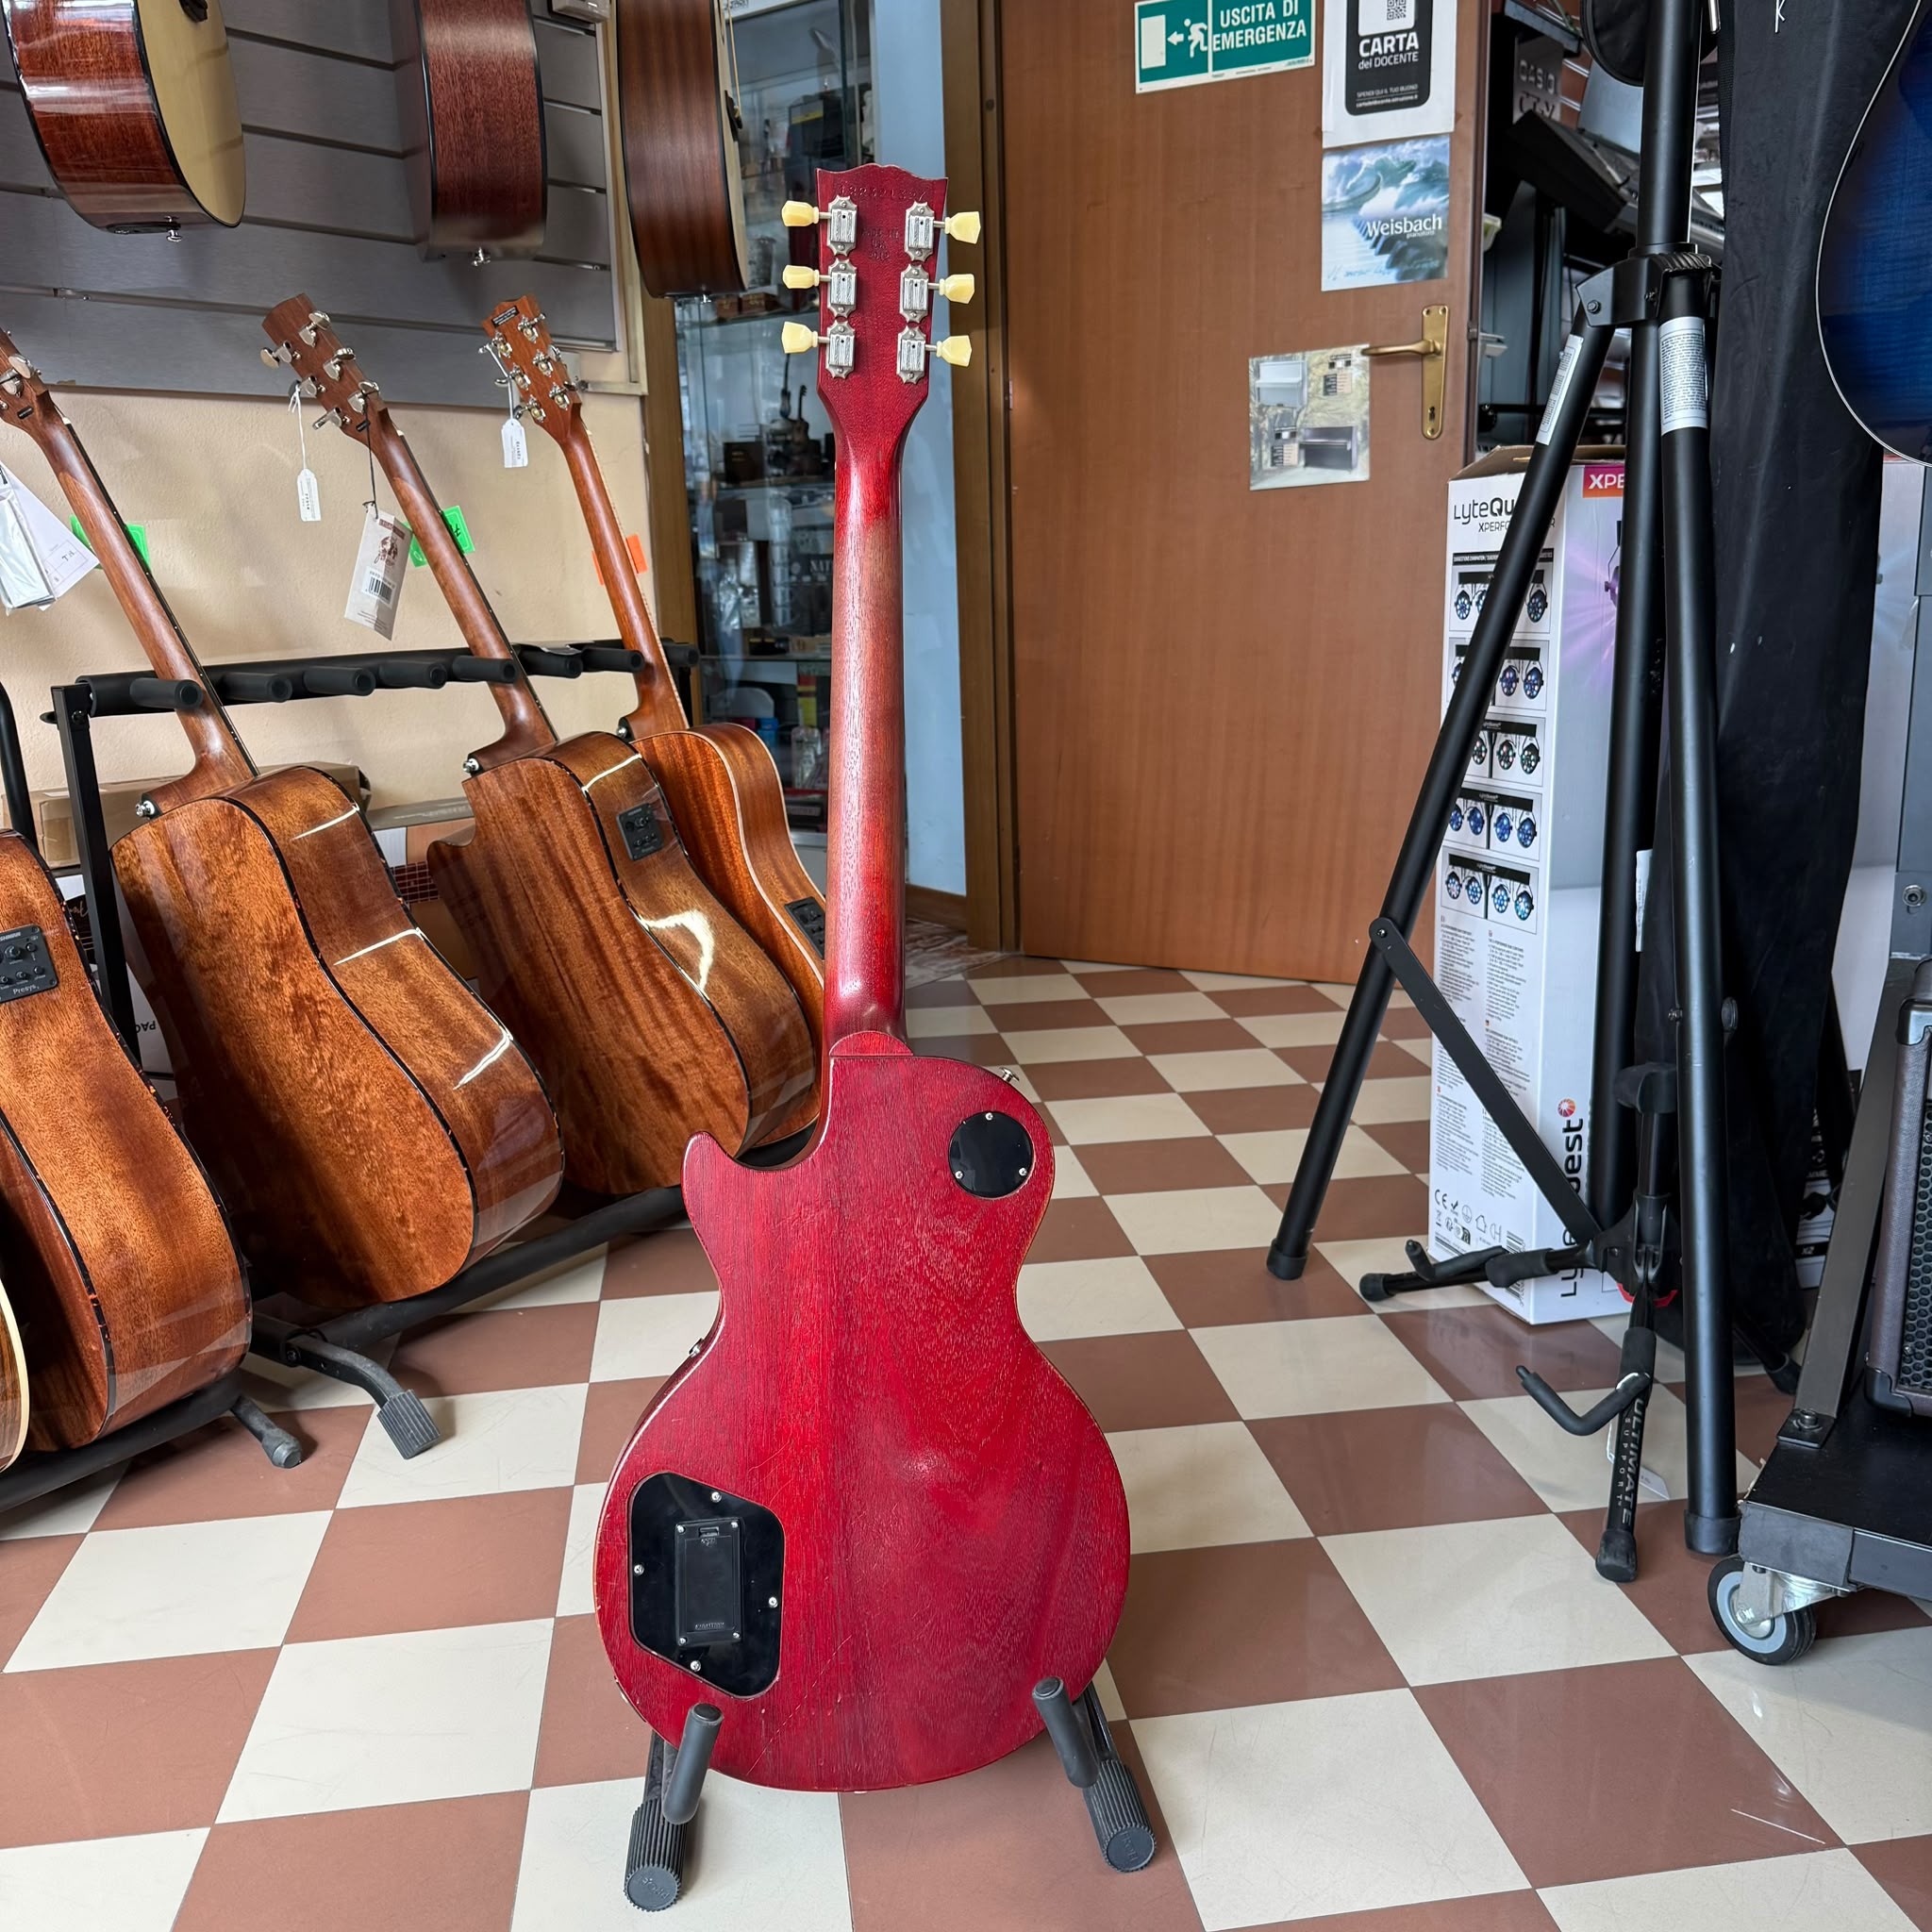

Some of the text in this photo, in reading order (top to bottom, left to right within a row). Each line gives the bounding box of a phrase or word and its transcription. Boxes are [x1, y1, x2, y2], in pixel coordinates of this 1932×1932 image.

[1220, 0, 1298, 28] USCITA DI
[1212, 19, 1307, 52] EMERGENZA
[1358, 31, 1419, 58] CARTA
[1358, 52, 1419, 70] del DOCENTE
[1520, 59, 1555, 95] CASIO
[1367, 213, 1442, 237] Weisbach
[1589, 474, 1624, 490] XPE
[1454, 496, 1515, 525] LyteQu
[134, 1019, 157, 1034] PAC
[1622, 1397, 1645, 1526] ULTIMATE
